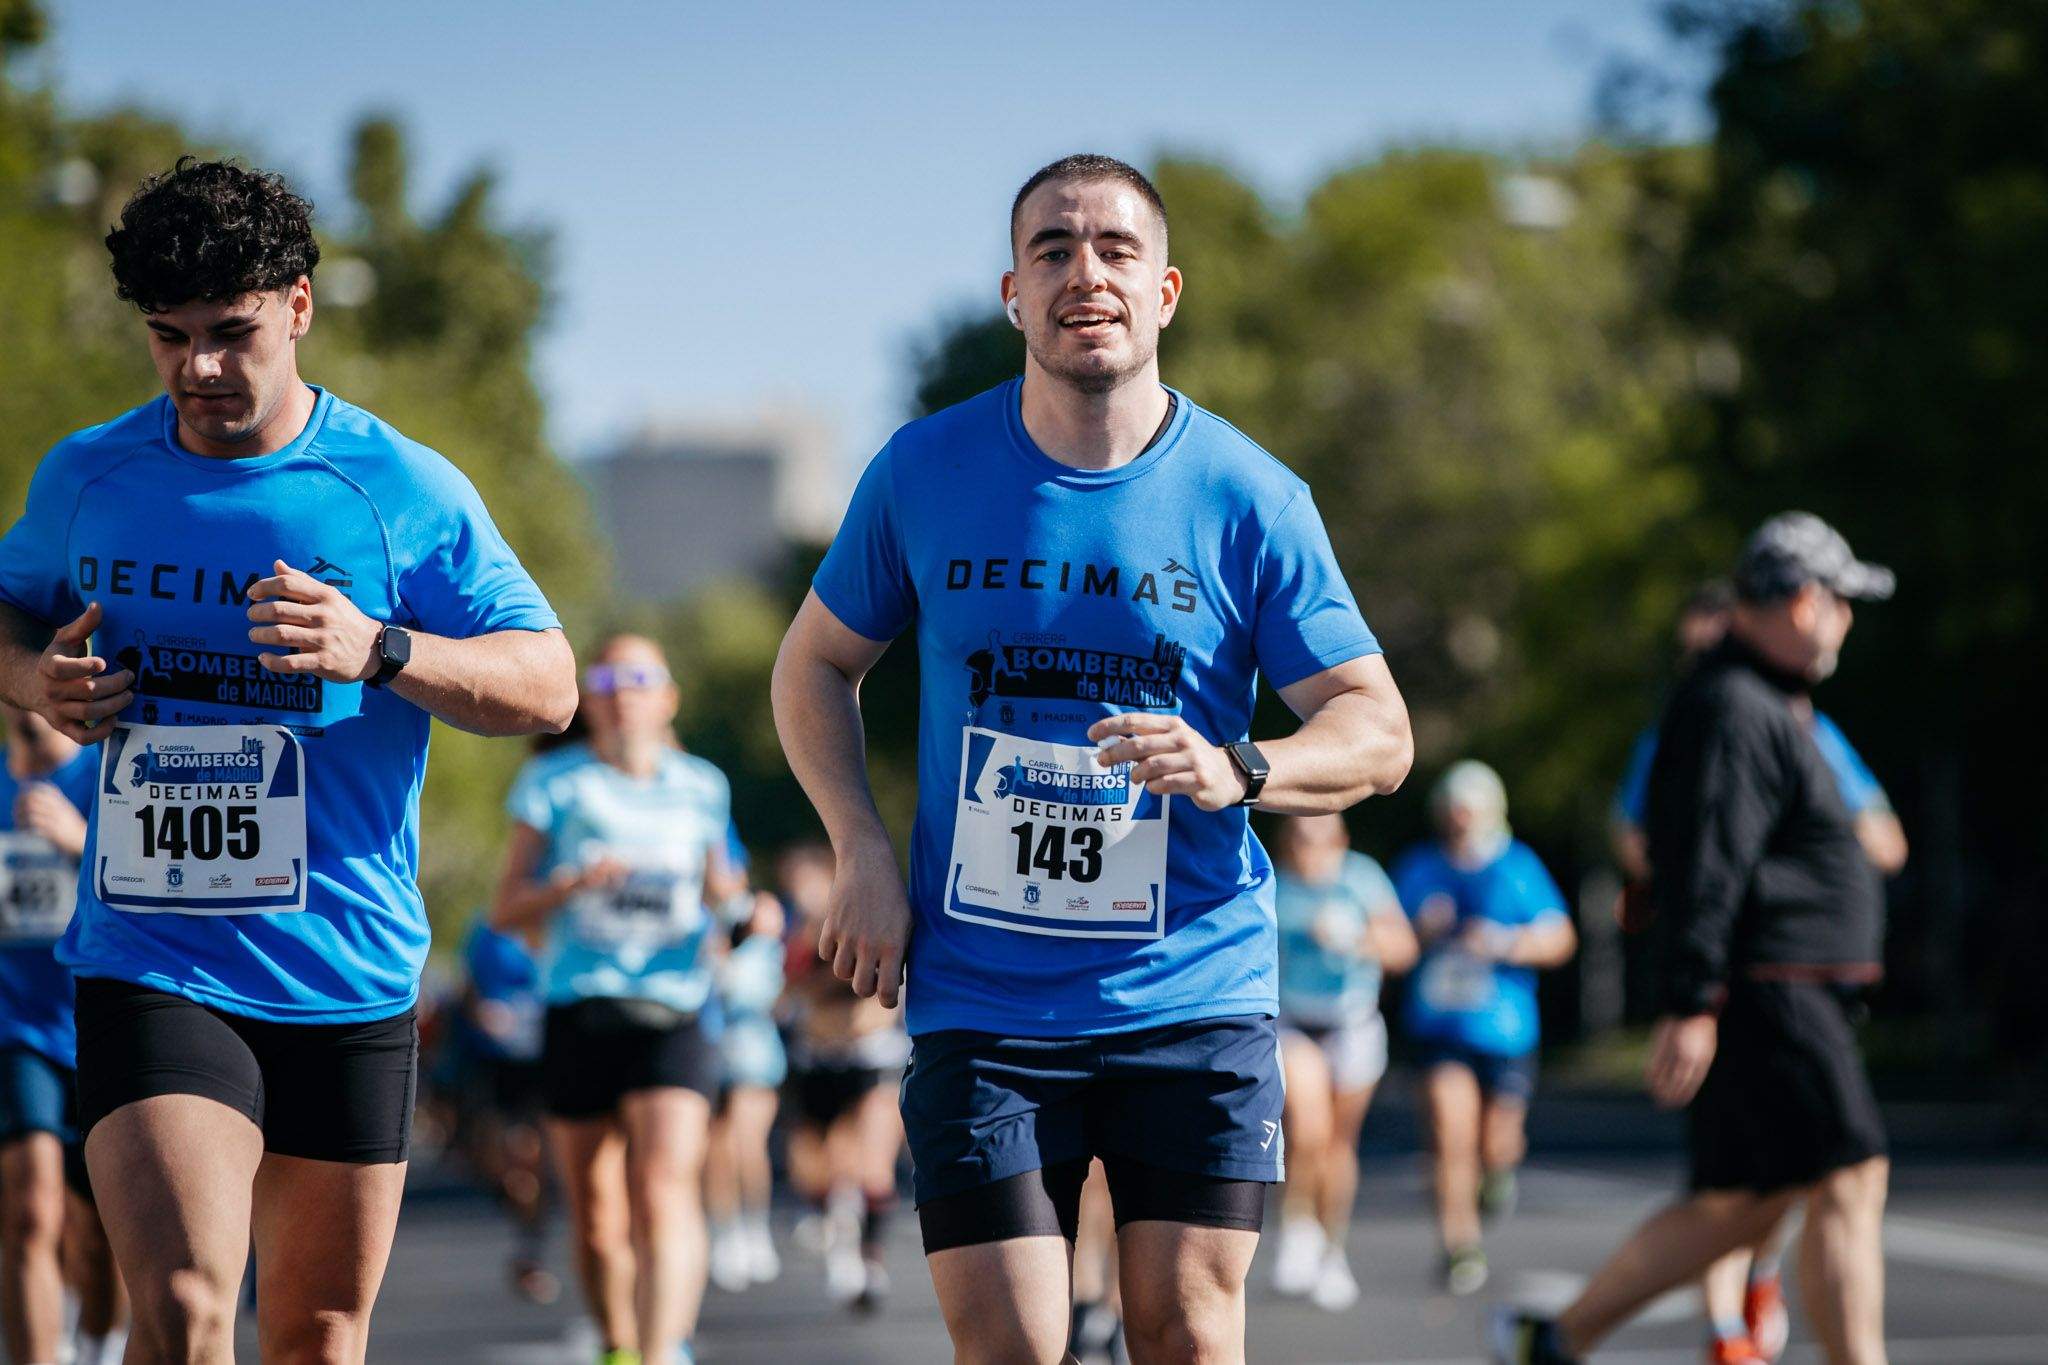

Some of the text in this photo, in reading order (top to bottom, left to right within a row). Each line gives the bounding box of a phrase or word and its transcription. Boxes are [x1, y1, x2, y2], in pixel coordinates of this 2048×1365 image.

[79, 555, 353, 606] DECIM
[946, 558, 1198, 614] DECIMAS
[1013, 649, 1176, 683] BOMBEROS
[217, 676, 317, 710] de MADRID
[1077, 675, 1172, 706] de MADRID
[158, 744, 196, 753] CARRERA
[158, 753, 260, 769] BOMBEROS
[196, 767, 260, 783] de MADRID
[1028, 759, 1066, 772] CARRERA
[149, 784, 258, 800] DECIMAS
[1026, 769, 1127, 790] BOMBEROS
[1062, 788, 1126, 804] de MADRID
[1013, 797, 1122, 822] DECIMAS
[134, 804, 261, 861] 1405
[1010, 821, 1104, 883] 143
